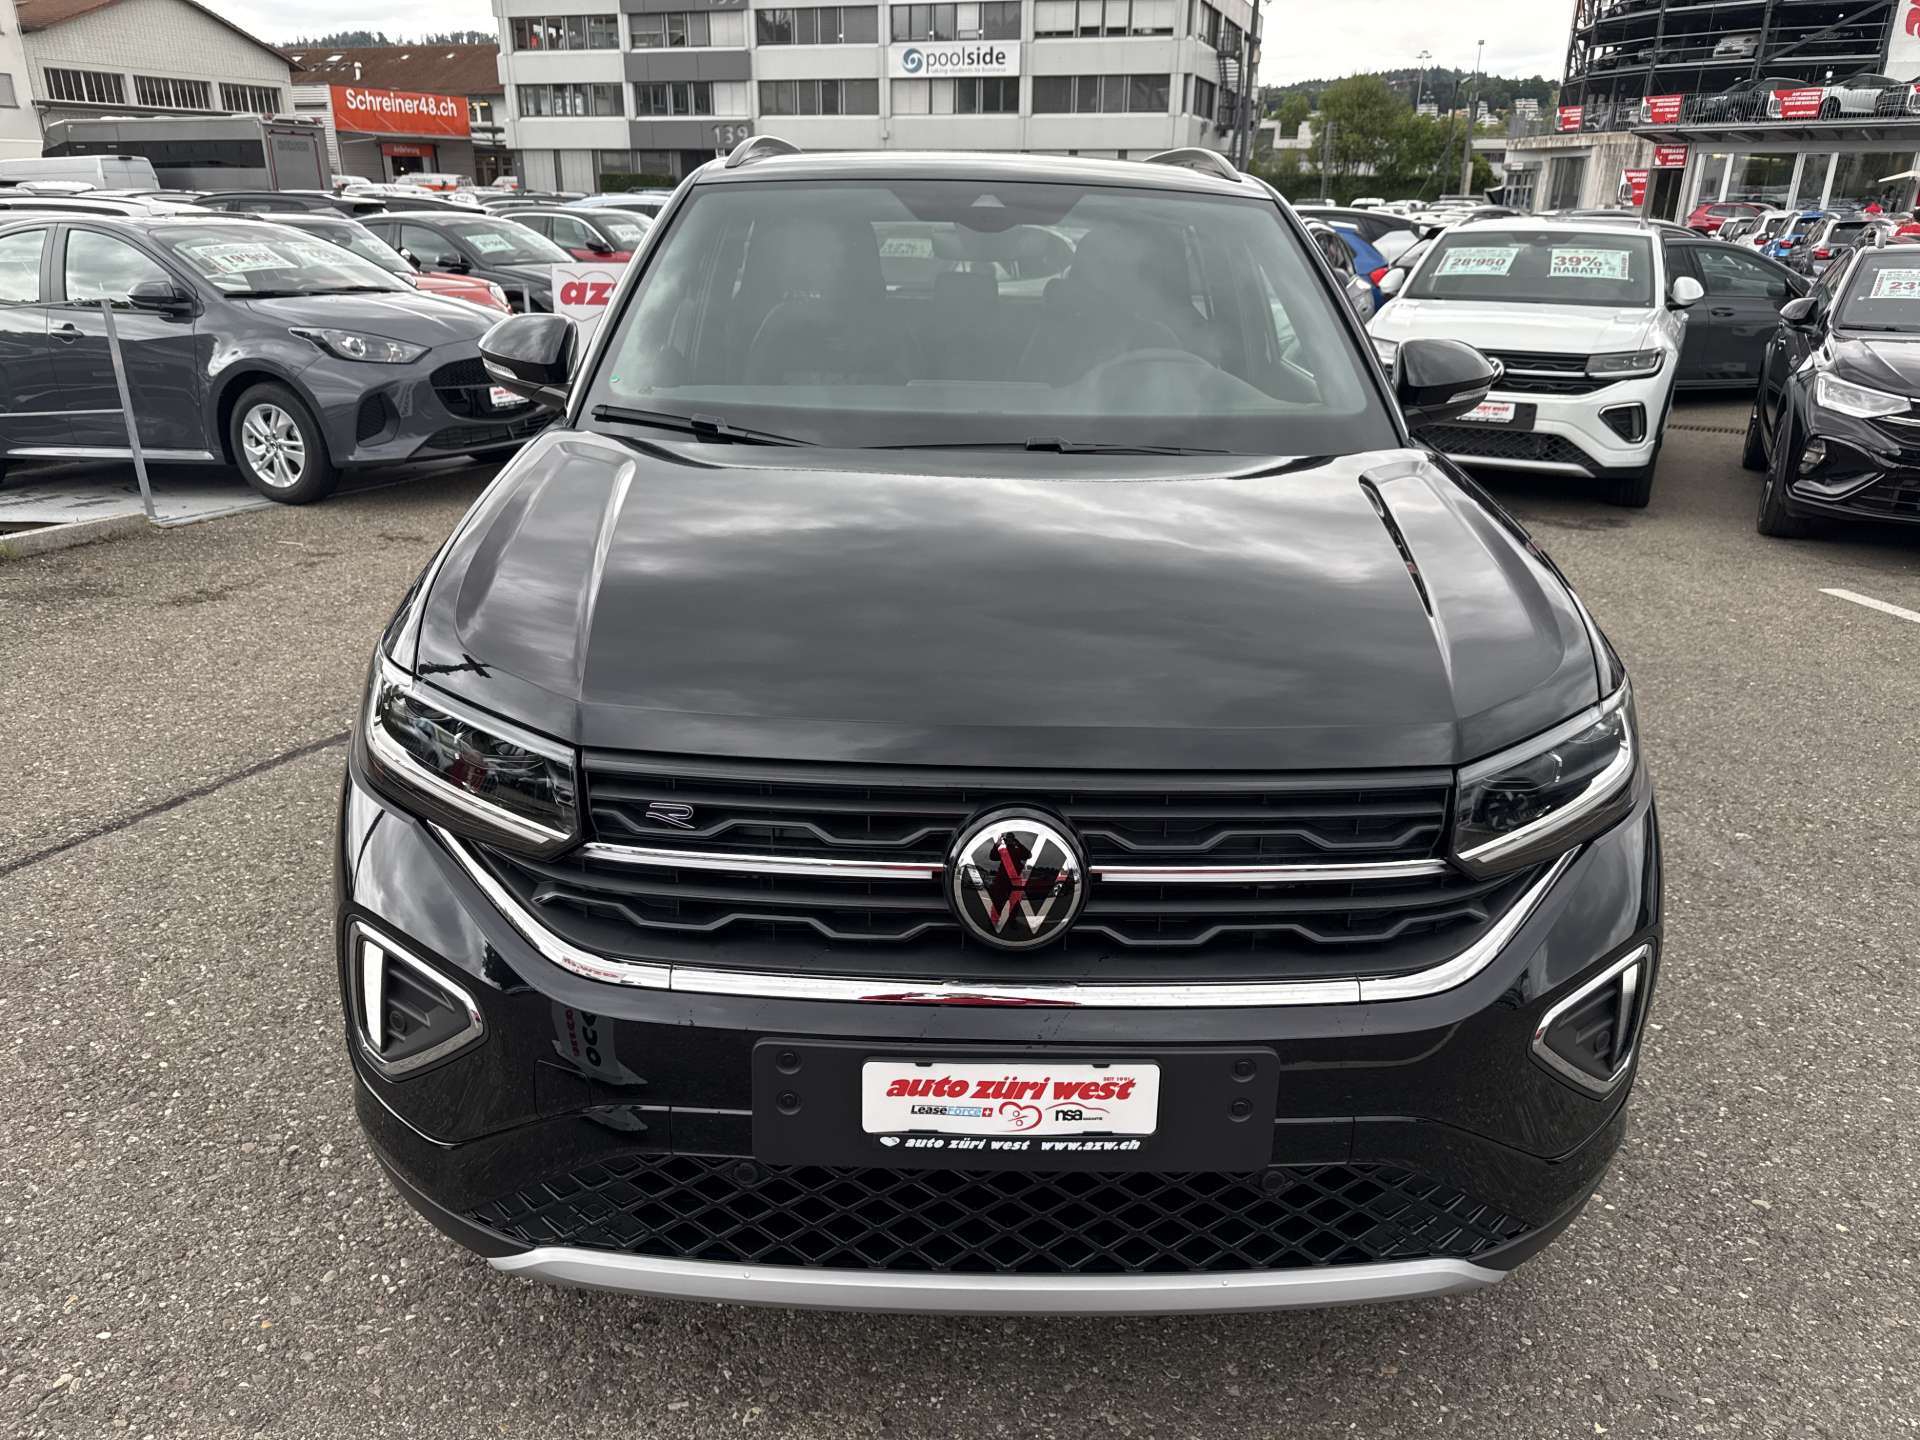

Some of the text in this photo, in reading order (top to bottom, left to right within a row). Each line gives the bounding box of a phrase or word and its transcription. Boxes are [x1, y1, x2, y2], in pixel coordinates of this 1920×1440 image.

[926, 46, 1006, 74] poolside
[345, 88, 457, 117] Schreiner48.ch
[713, 125, 749, 144] 139
[1554, 256, 1603, 267] 39%
[1553, 266, 1602, 274] RABATT
[886, 1076, 1136, 1100] auto züri west
[1055, 1109, 1083, 1121] nsa
[905, 1137, 1141, 1151] auto züri west www.azw.ch
